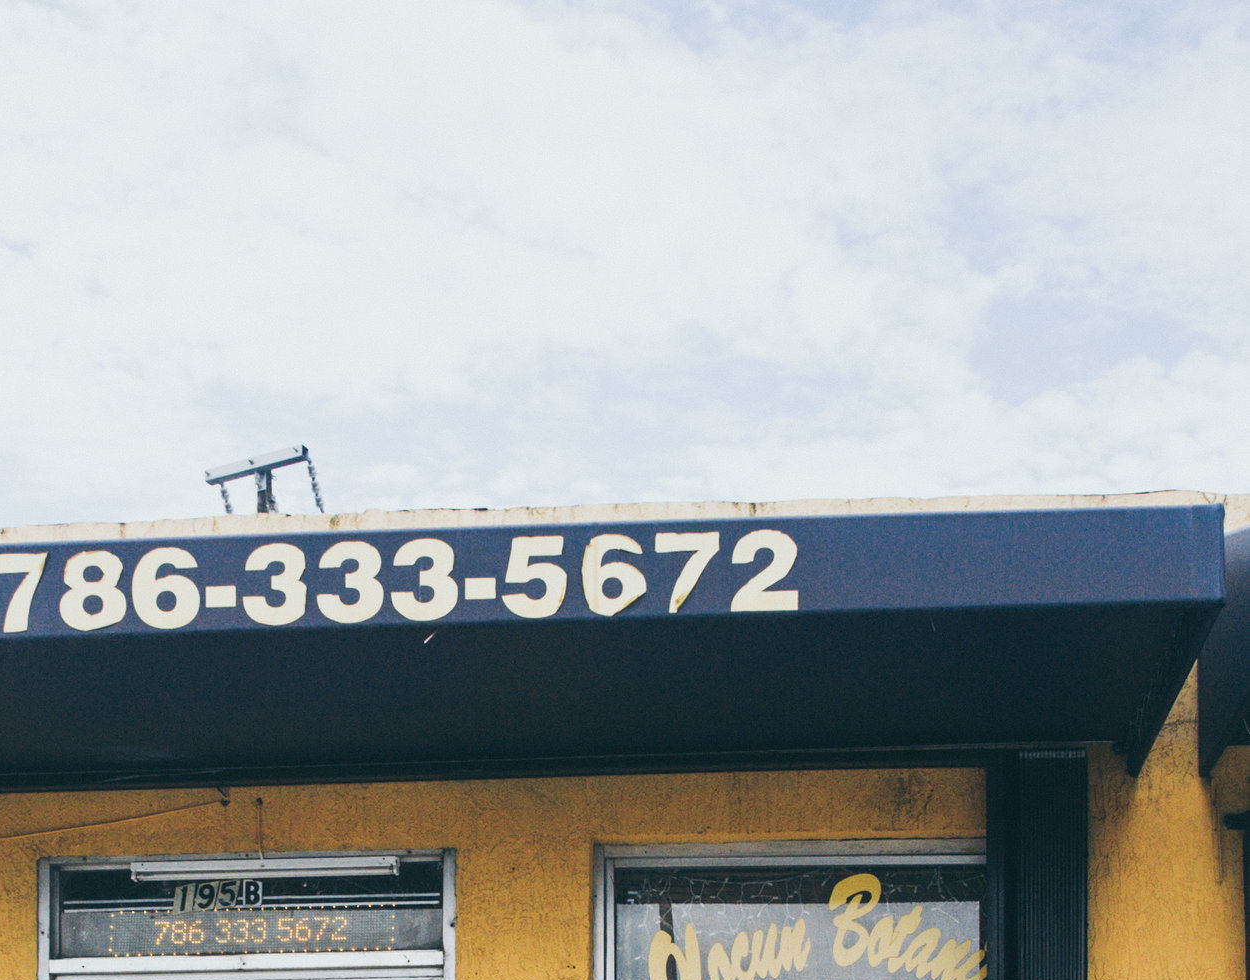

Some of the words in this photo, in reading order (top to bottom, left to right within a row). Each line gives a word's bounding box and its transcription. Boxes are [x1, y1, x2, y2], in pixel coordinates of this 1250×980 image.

[155, 919, 204, 945] 786
[215, 918, 267, 943] 333
[277, 916, 349, 942] 5672
